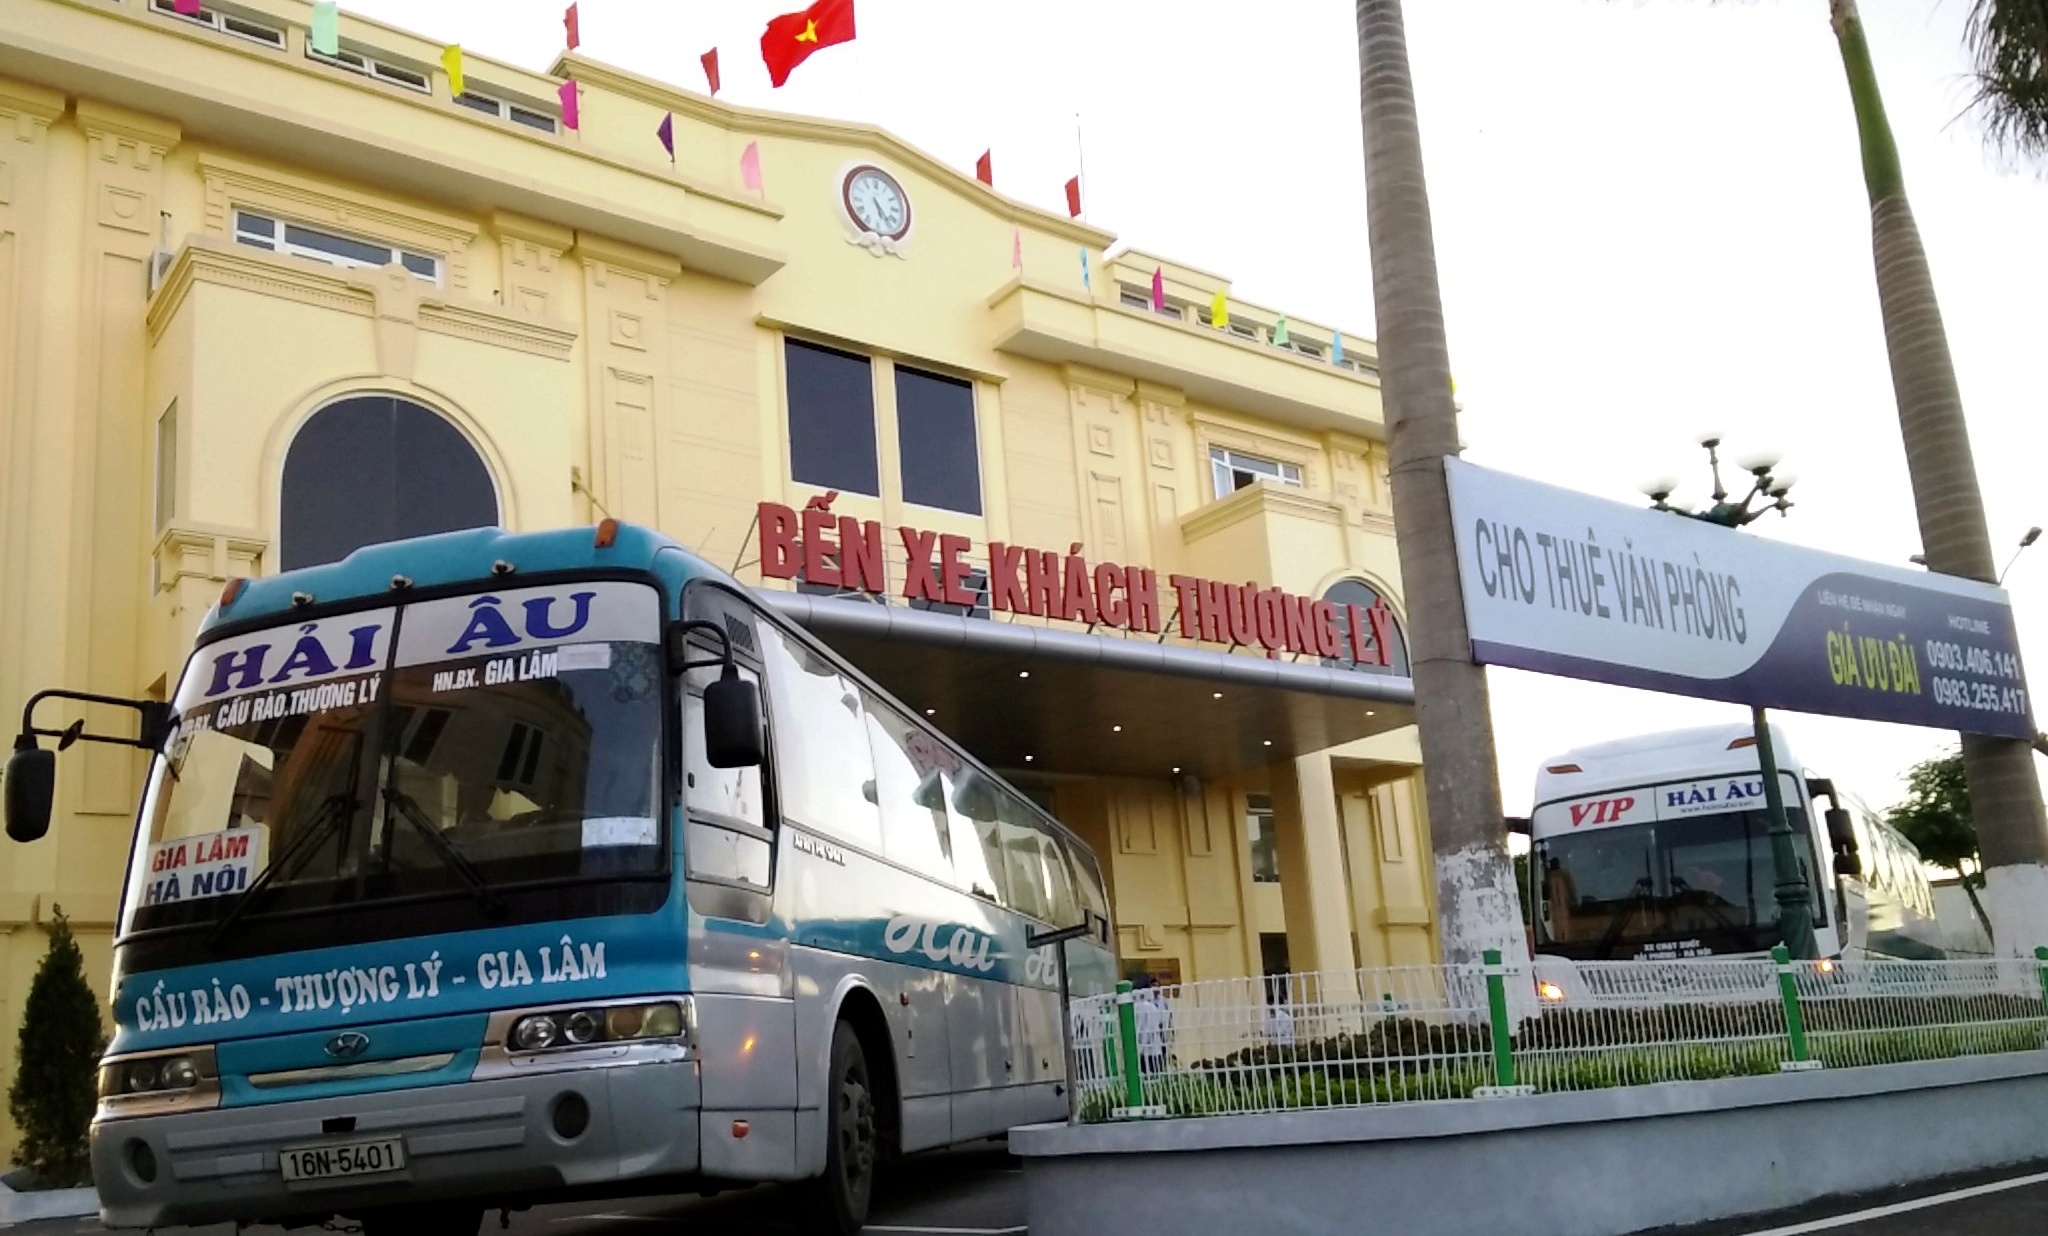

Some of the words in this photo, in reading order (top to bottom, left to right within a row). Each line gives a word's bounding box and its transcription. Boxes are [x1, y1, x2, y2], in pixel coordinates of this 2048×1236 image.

[758, 490, 884, 593] BẾN
[898, 526, 977, 606] XE
[987, 541, 1161, 634] KHÁCH
[1170, 573, 1343, 660] THƯỢNG
[1347, 594, 1393, 667] LÝ
[1475, 517, 1535, 605] CHO
[1536, 526, 1611, 619] THUÊ
[1608, 535, 1665, 629] VĂN
[1663, 550, 1747, 645] PHÒNG
[204, 622, 383, 697] HẢI
[446, 591, 597, 654] ÂU
[1826, 620, 1862, 687] GIÁ
[1926, 639, 2020, 680] 0903.406.141
[358, 671, 382, 703] LÝ
[484, 657, 516, 686] GIA
[518, 649, 558, 682] LÂM
[1932, 675, 2026, 715] 0983.255.417
[1569, 796, 1635, 827] VIP
[1666, 783, 1718, 807] HẢI
[1726, 780, 1764, 800] ÂU
[152, 844, 187, 873] GIA
[195, 833, 249, 864] LÂM
[144, 872, 180, 907] HÀ
[191, 976, 251, 1026] RÀO
[275, 965, 401, 1016] THƯỢNG
[404, 950, 443, 999] LÝ
[477, 948, 534, 990] GIA
[539, 933, 608, 984] LÂM
[290, 1143, 395, 1178] 16N-5401
